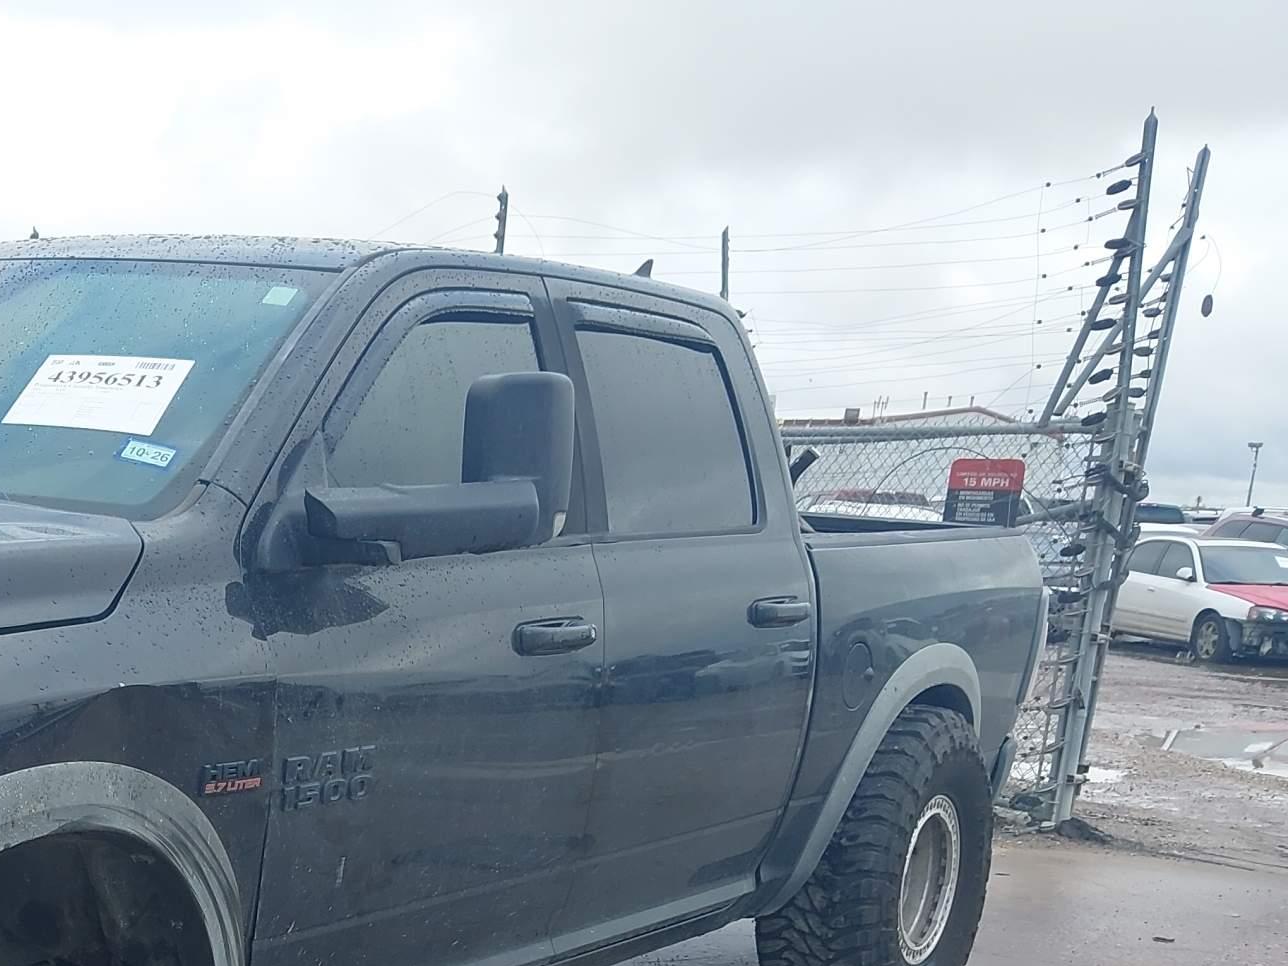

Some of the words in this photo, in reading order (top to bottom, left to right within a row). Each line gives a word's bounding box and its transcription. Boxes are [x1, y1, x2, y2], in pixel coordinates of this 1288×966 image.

[48, 370, 163, 388] 43956513
[129, 446, 146, 457] 10
[151, 451, 170, 462] 26
[963, 478, 977, 487] 15
[980, 478, 1009, 487] MPH
[283, 744, 376, 783] RAM
[204, 781, 227, 794] 5.7
[227, 777, 261, 791] LITER
[281, 775, 374, 812] 1500
